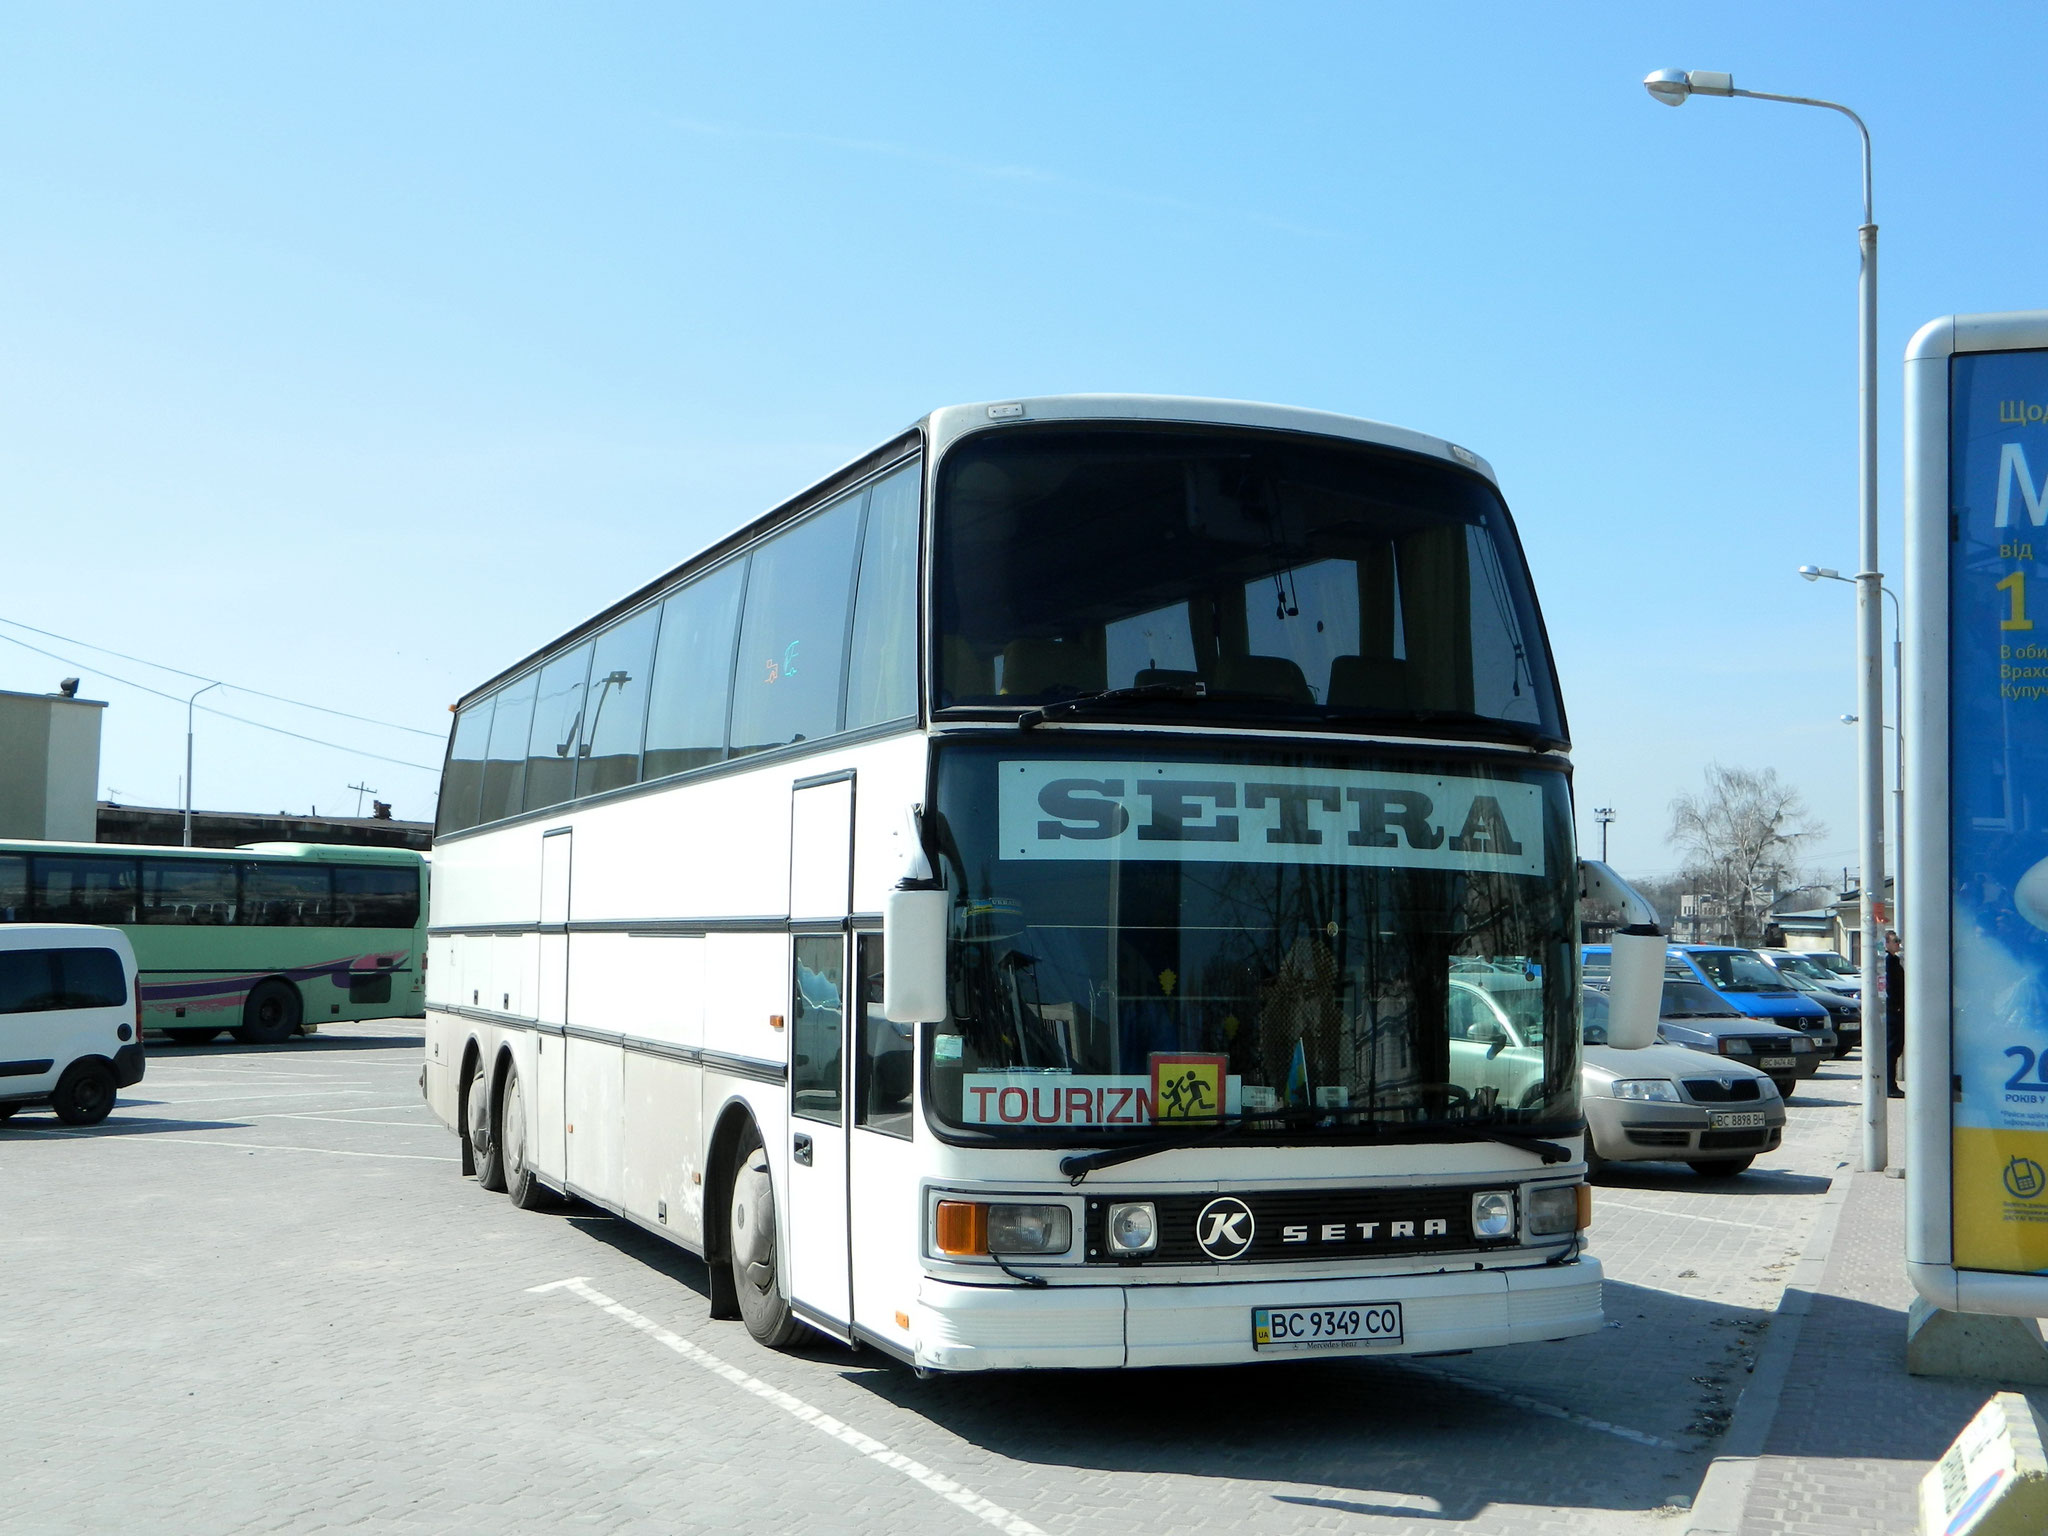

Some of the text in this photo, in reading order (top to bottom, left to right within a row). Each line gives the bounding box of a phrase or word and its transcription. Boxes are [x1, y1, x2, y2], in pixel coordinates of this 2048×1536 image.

[2000, 539, 2033, 560] від
[1038, 778, 1522, 855] SETRA
[2005, 1094, 2037, 1103] РОКІВ
[1717, 1115, 1729, 1126] BC
[1283, 1218, 1447, 1243] SETRA
[1271, 1309, 1396, 1338] BC 9349 CO
